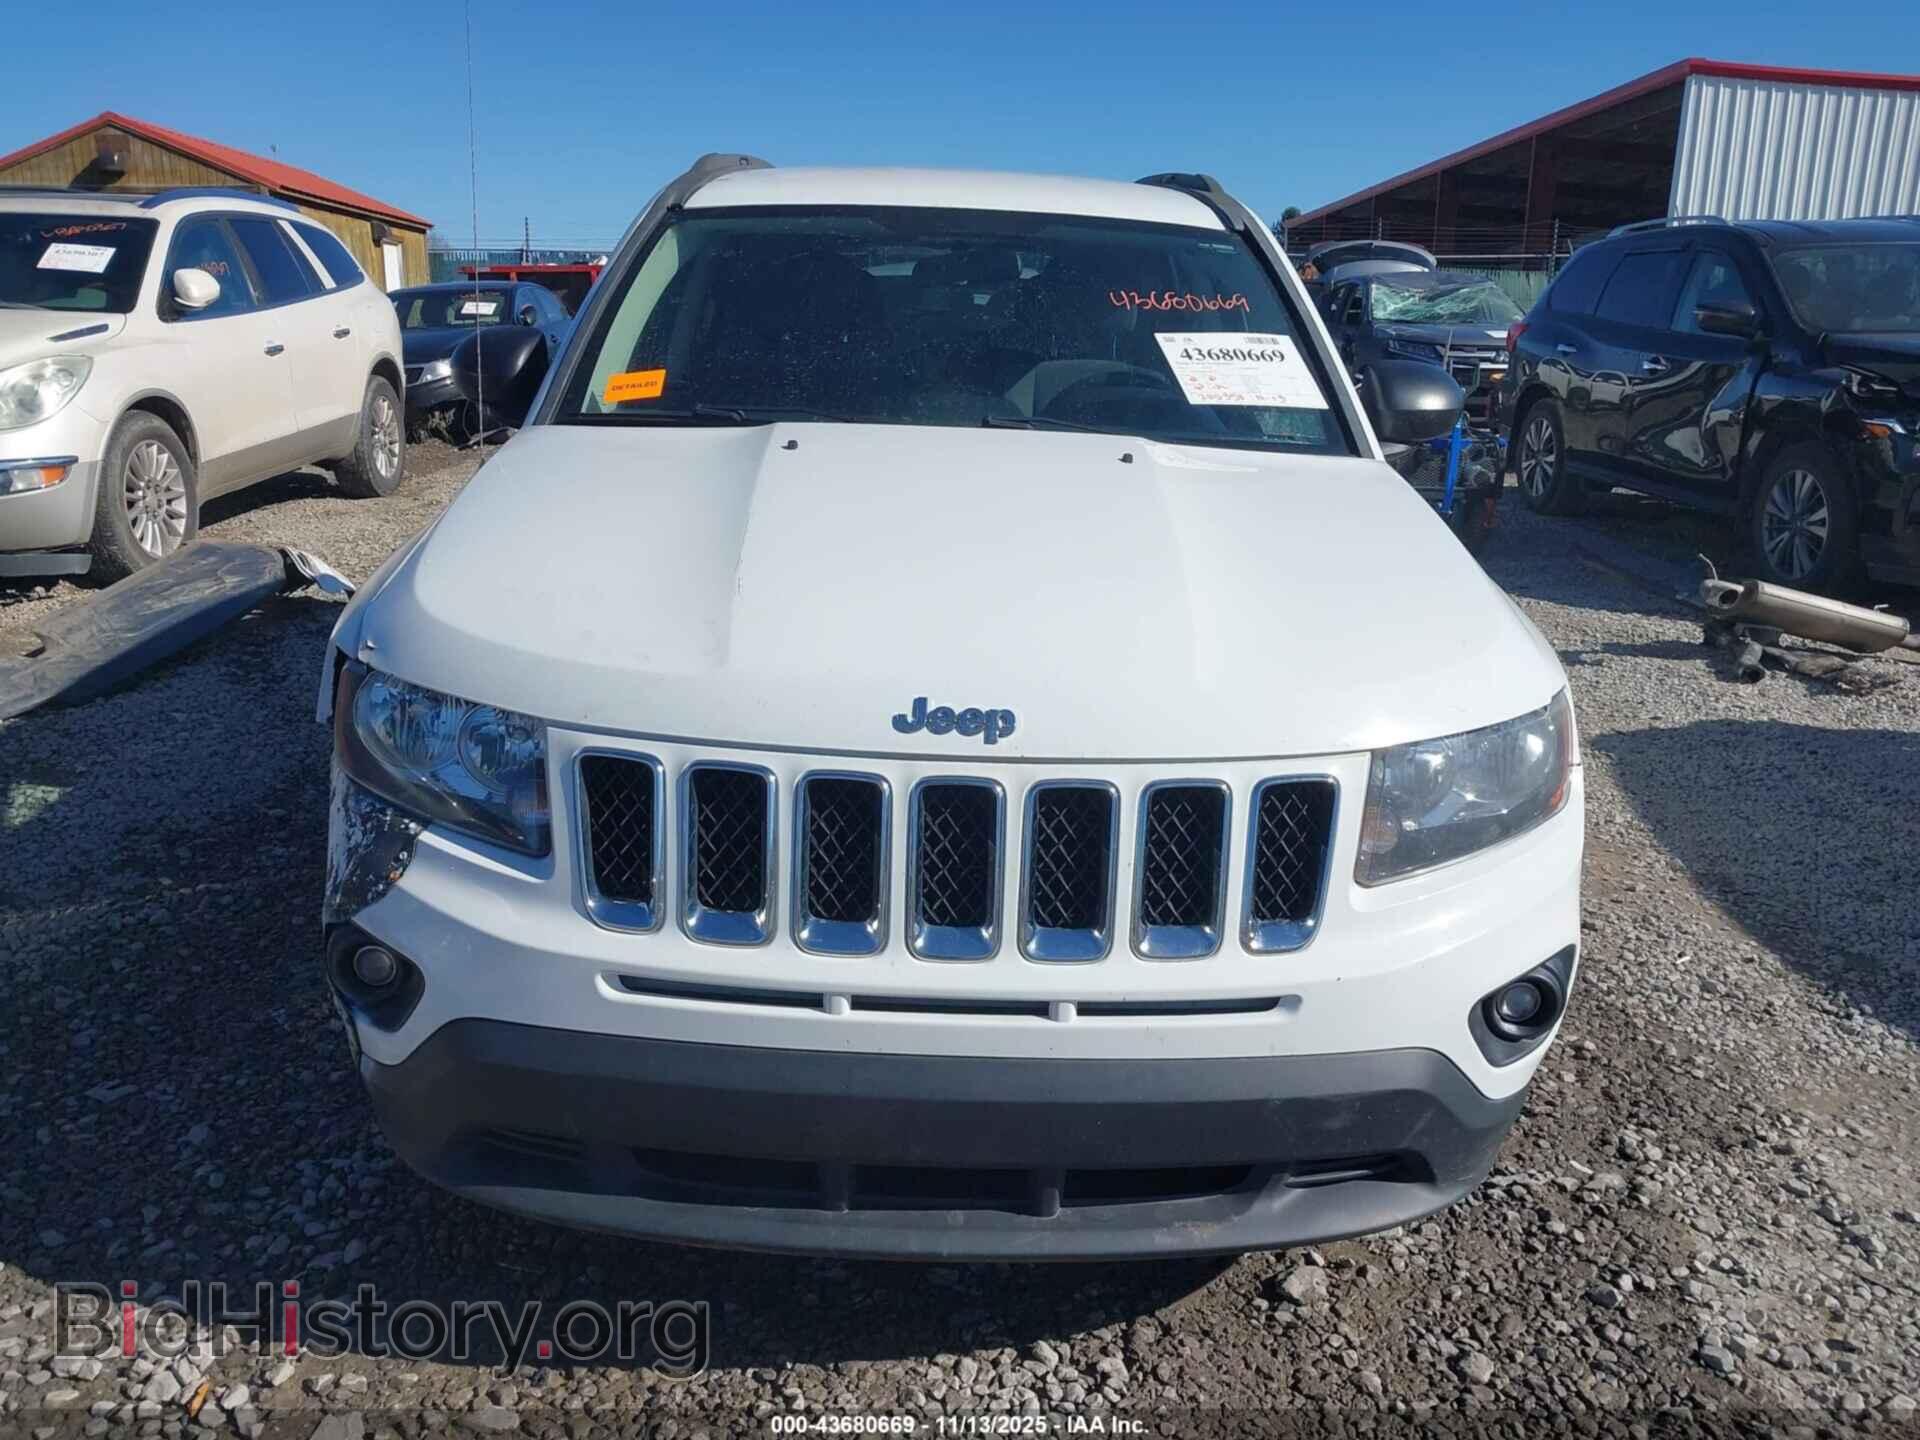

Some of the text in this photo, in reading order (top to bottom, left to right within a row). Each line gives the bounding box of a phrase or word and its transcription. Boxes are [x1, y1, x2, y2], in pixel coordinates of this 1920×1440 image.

[1109, 290, 1250, 313] 43680669
[1179, 347, 1285, 362] 43680669
[891, 696, 1016, 745] Jeep
